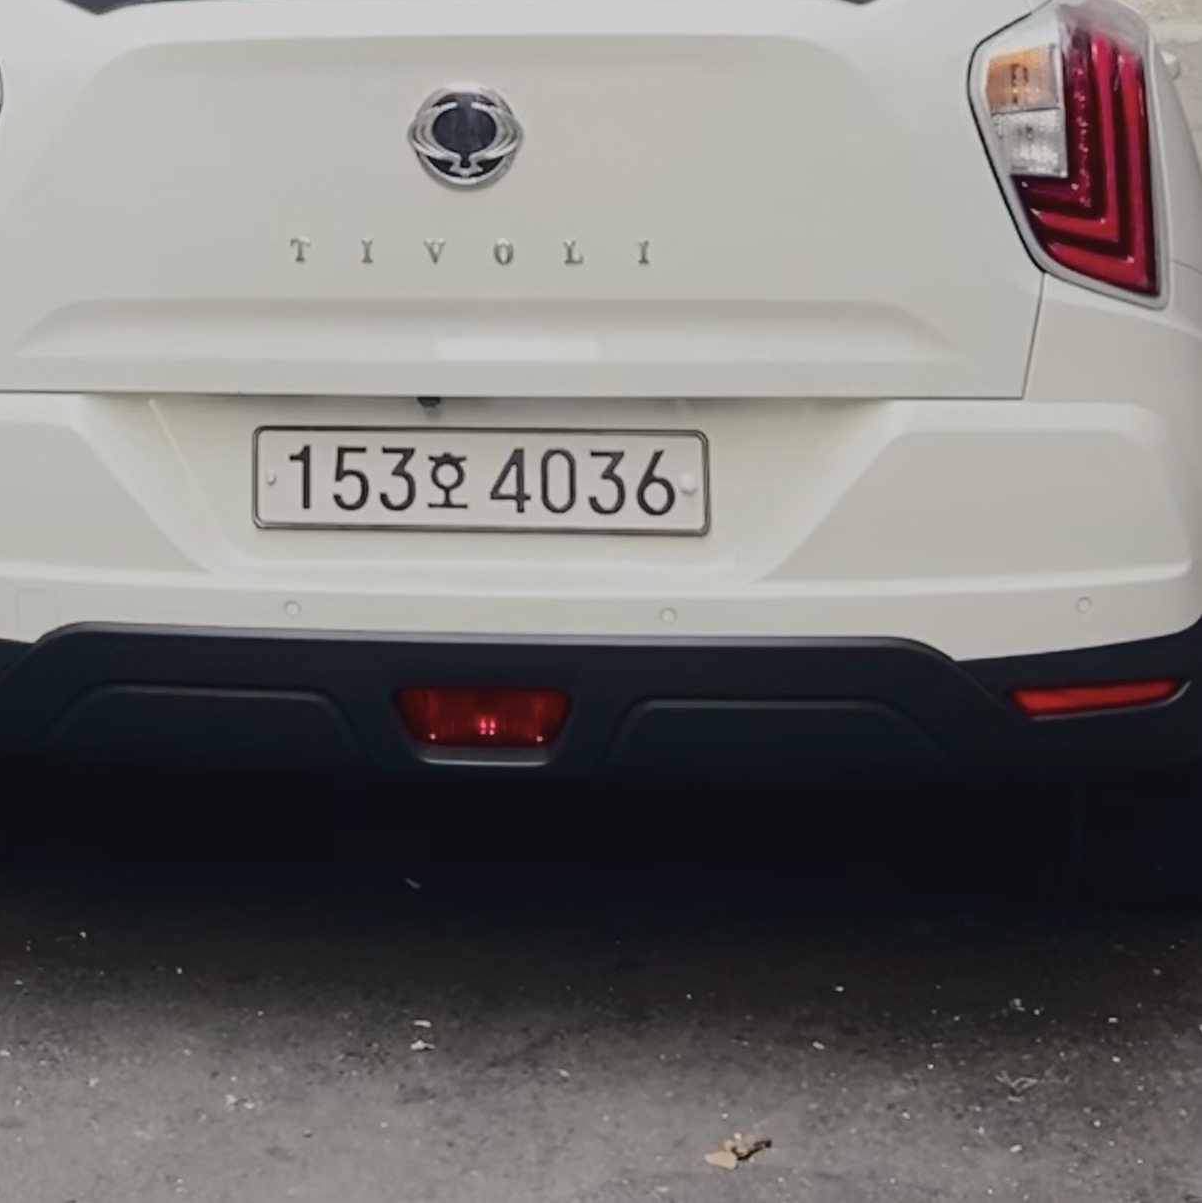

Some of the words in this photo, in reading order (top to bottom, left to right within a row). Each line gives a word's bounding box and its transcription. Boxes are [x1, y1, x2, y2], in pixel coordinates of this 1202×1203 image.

[290, 238, 650, 265] TIVOLI
[289, 445, 468, 511] 153호
[489, 448, 676, 516] 4036
